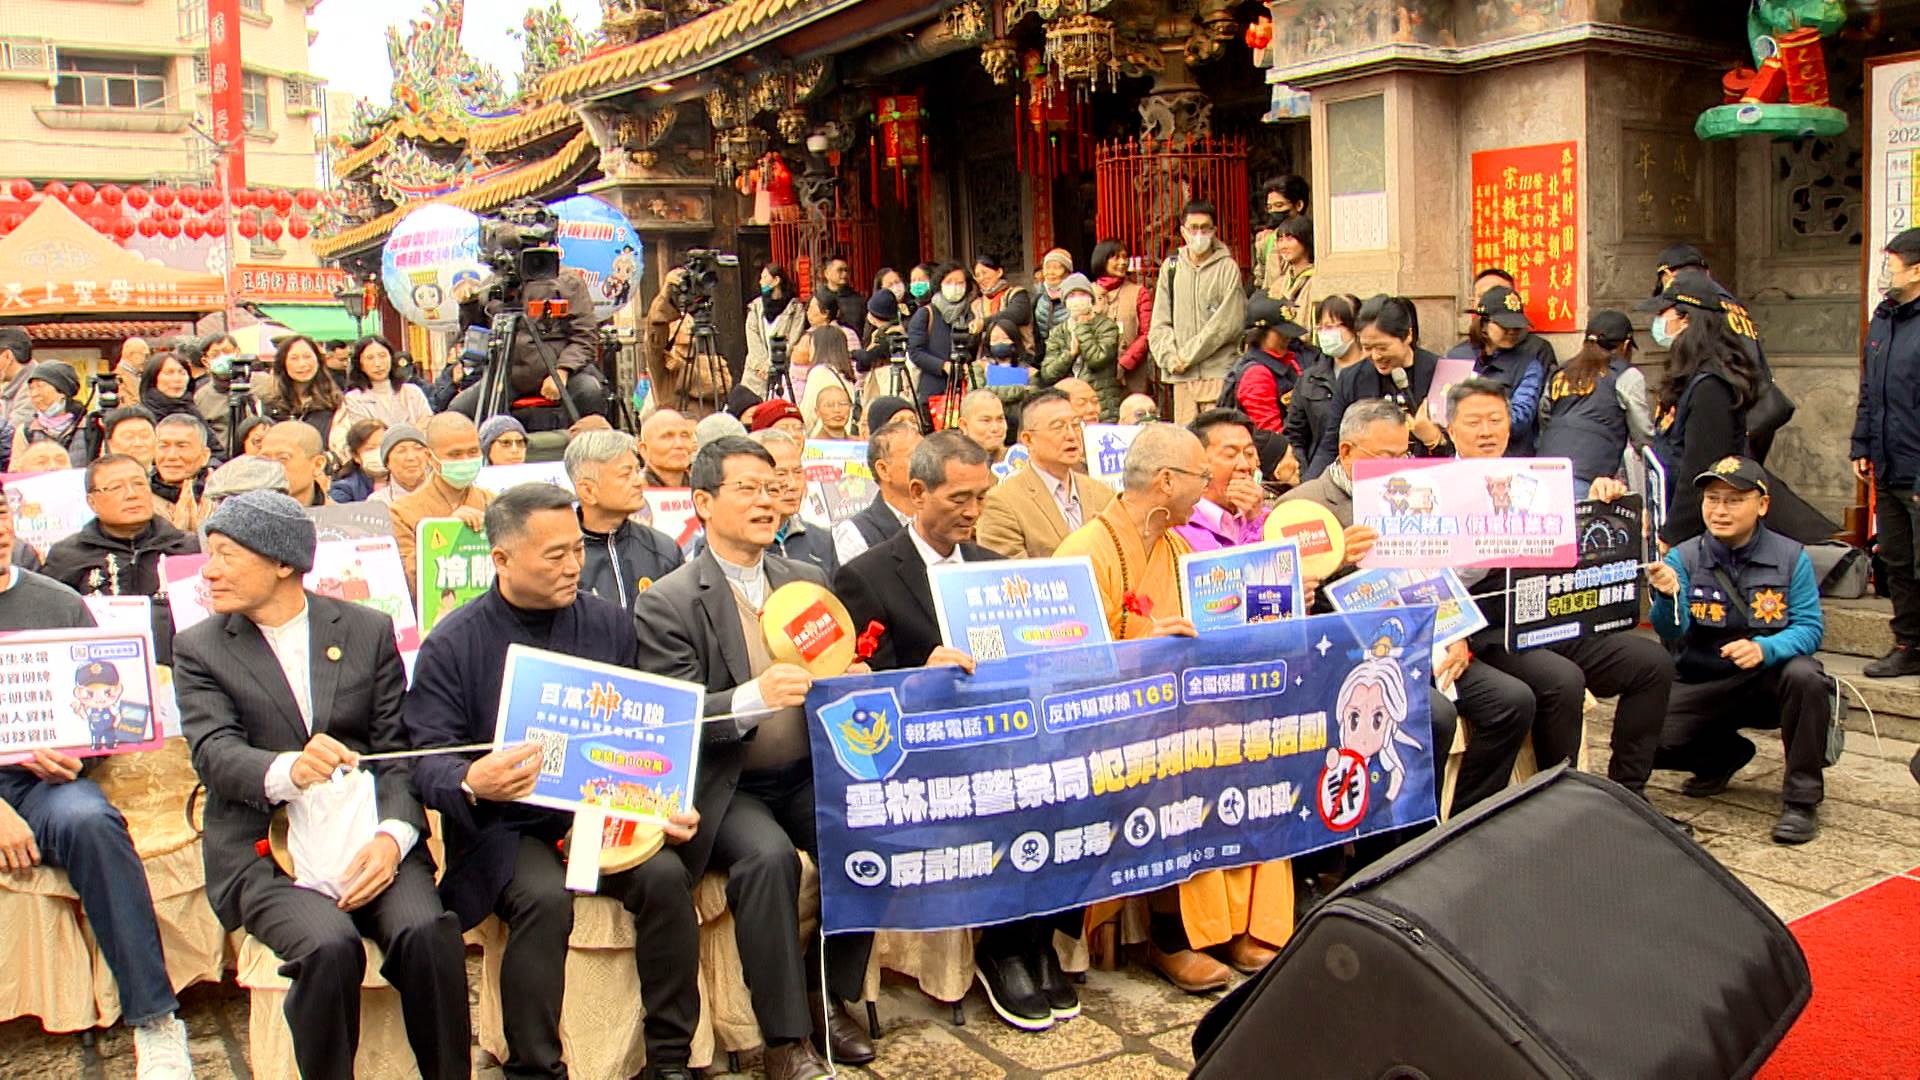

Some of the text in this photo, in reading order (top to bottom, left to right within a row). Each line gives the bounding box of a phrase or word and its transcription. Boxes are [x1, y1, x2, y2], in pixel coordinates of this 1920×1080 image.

[1892, 207, 1905, 228] 2
[1547, 173, 1561, 321] 北港朝天宮
[4, 279, 135, 308] 天上聖母
[0, 651, 49, 666] 生來電
